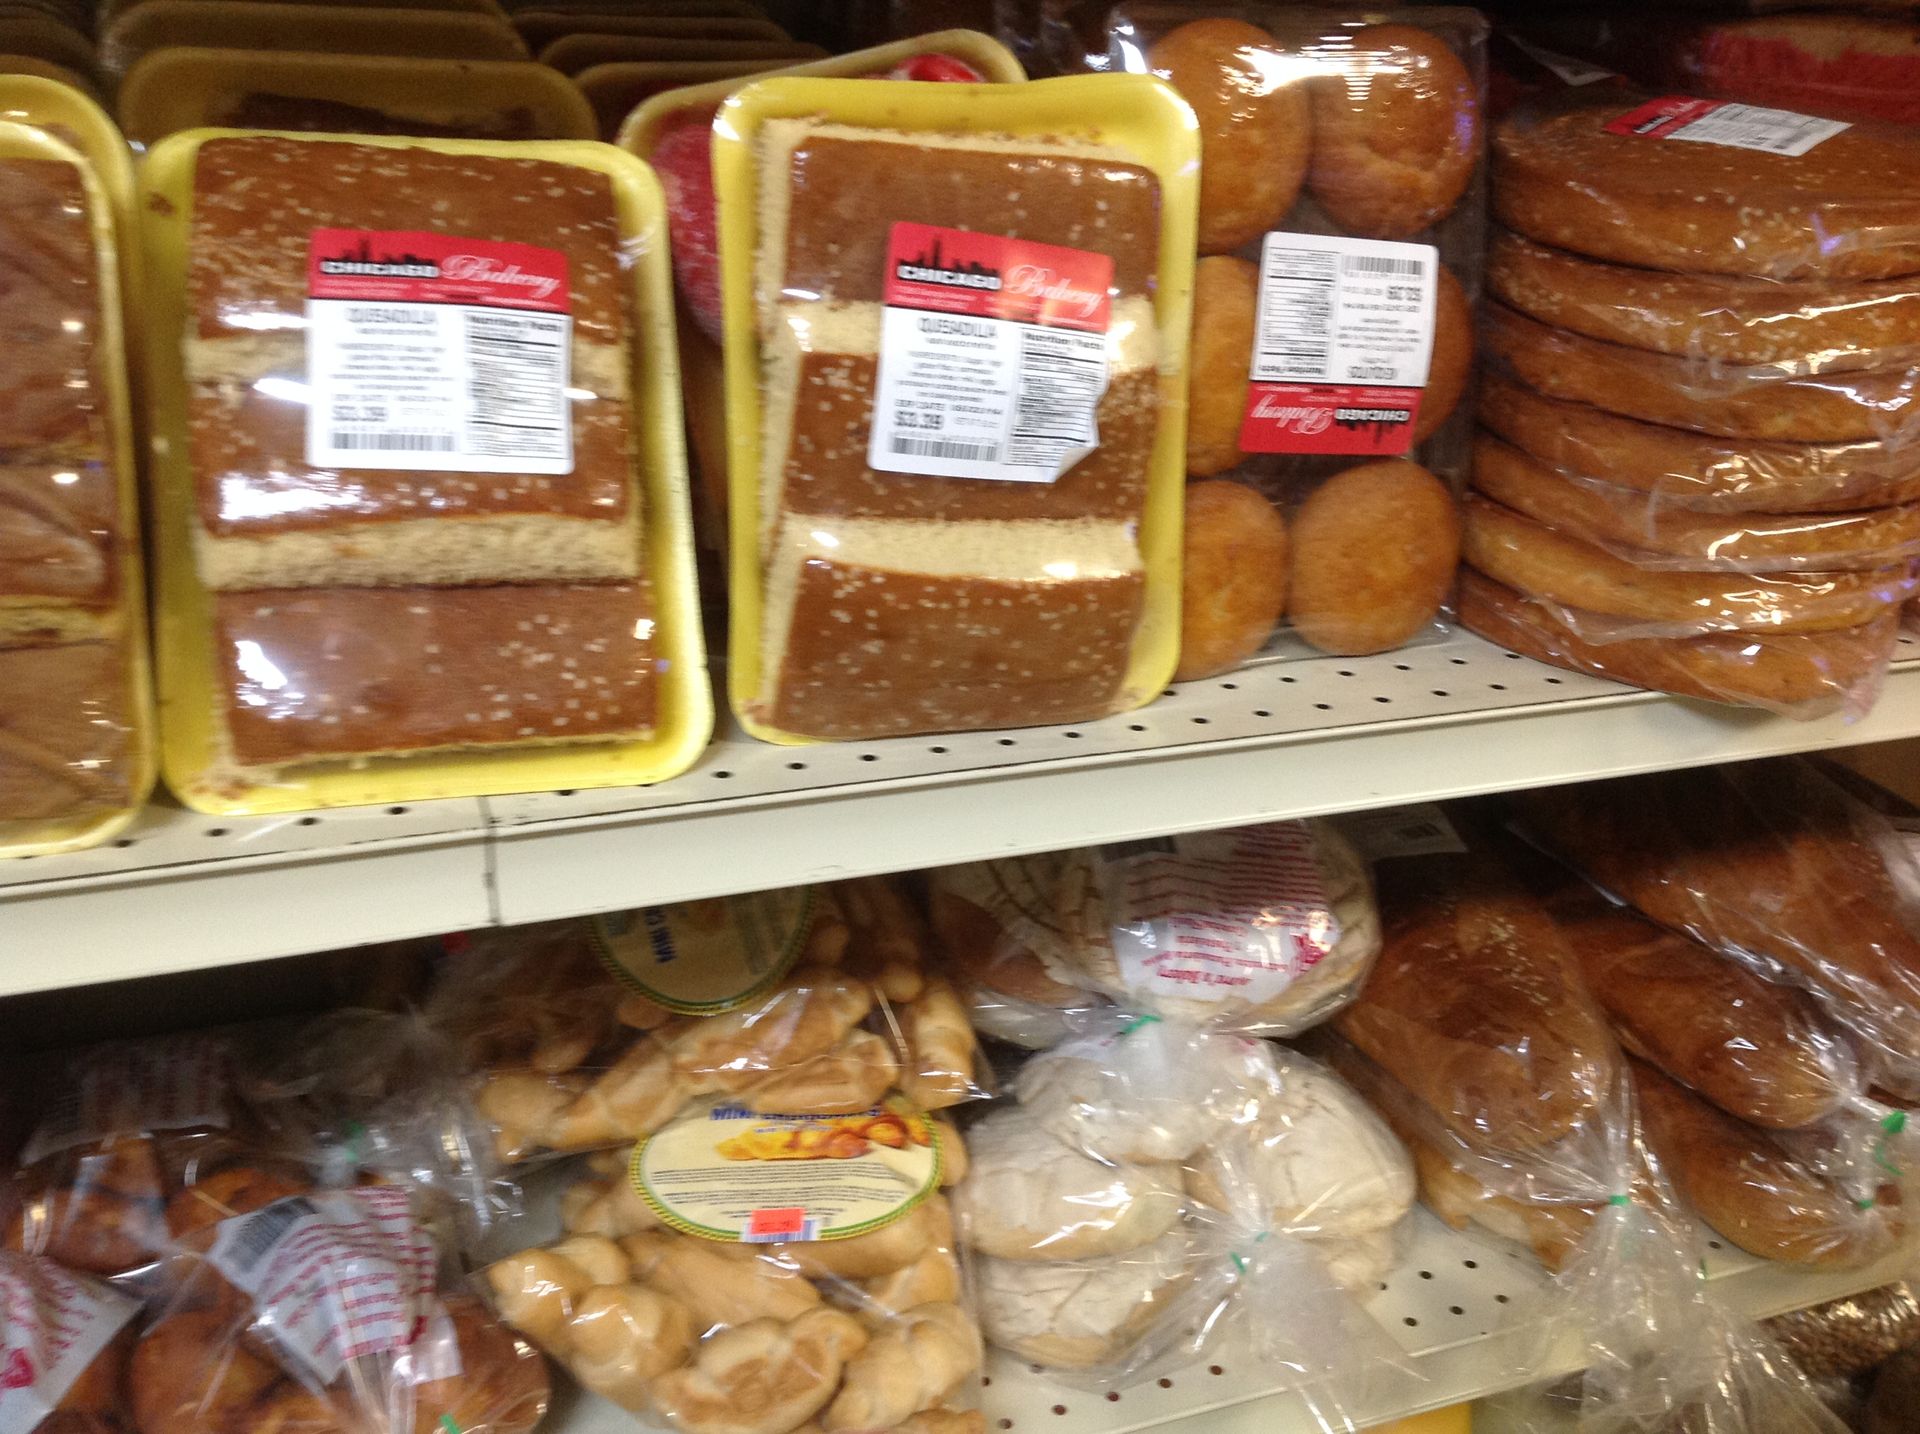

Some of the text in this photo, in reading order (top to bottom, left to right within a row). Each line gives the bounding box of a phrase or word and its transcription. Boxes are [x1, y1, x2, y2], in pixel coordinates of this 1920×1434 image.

[441, 254, 561, 298] Bakery
[898, 265, 1002, 290] CHICAGO
[1003, 263, 1104, 317] Bakery
[1251, 394, 1333, 435] Bakery
[1335, 407, 1411, 422] CHICAGO
